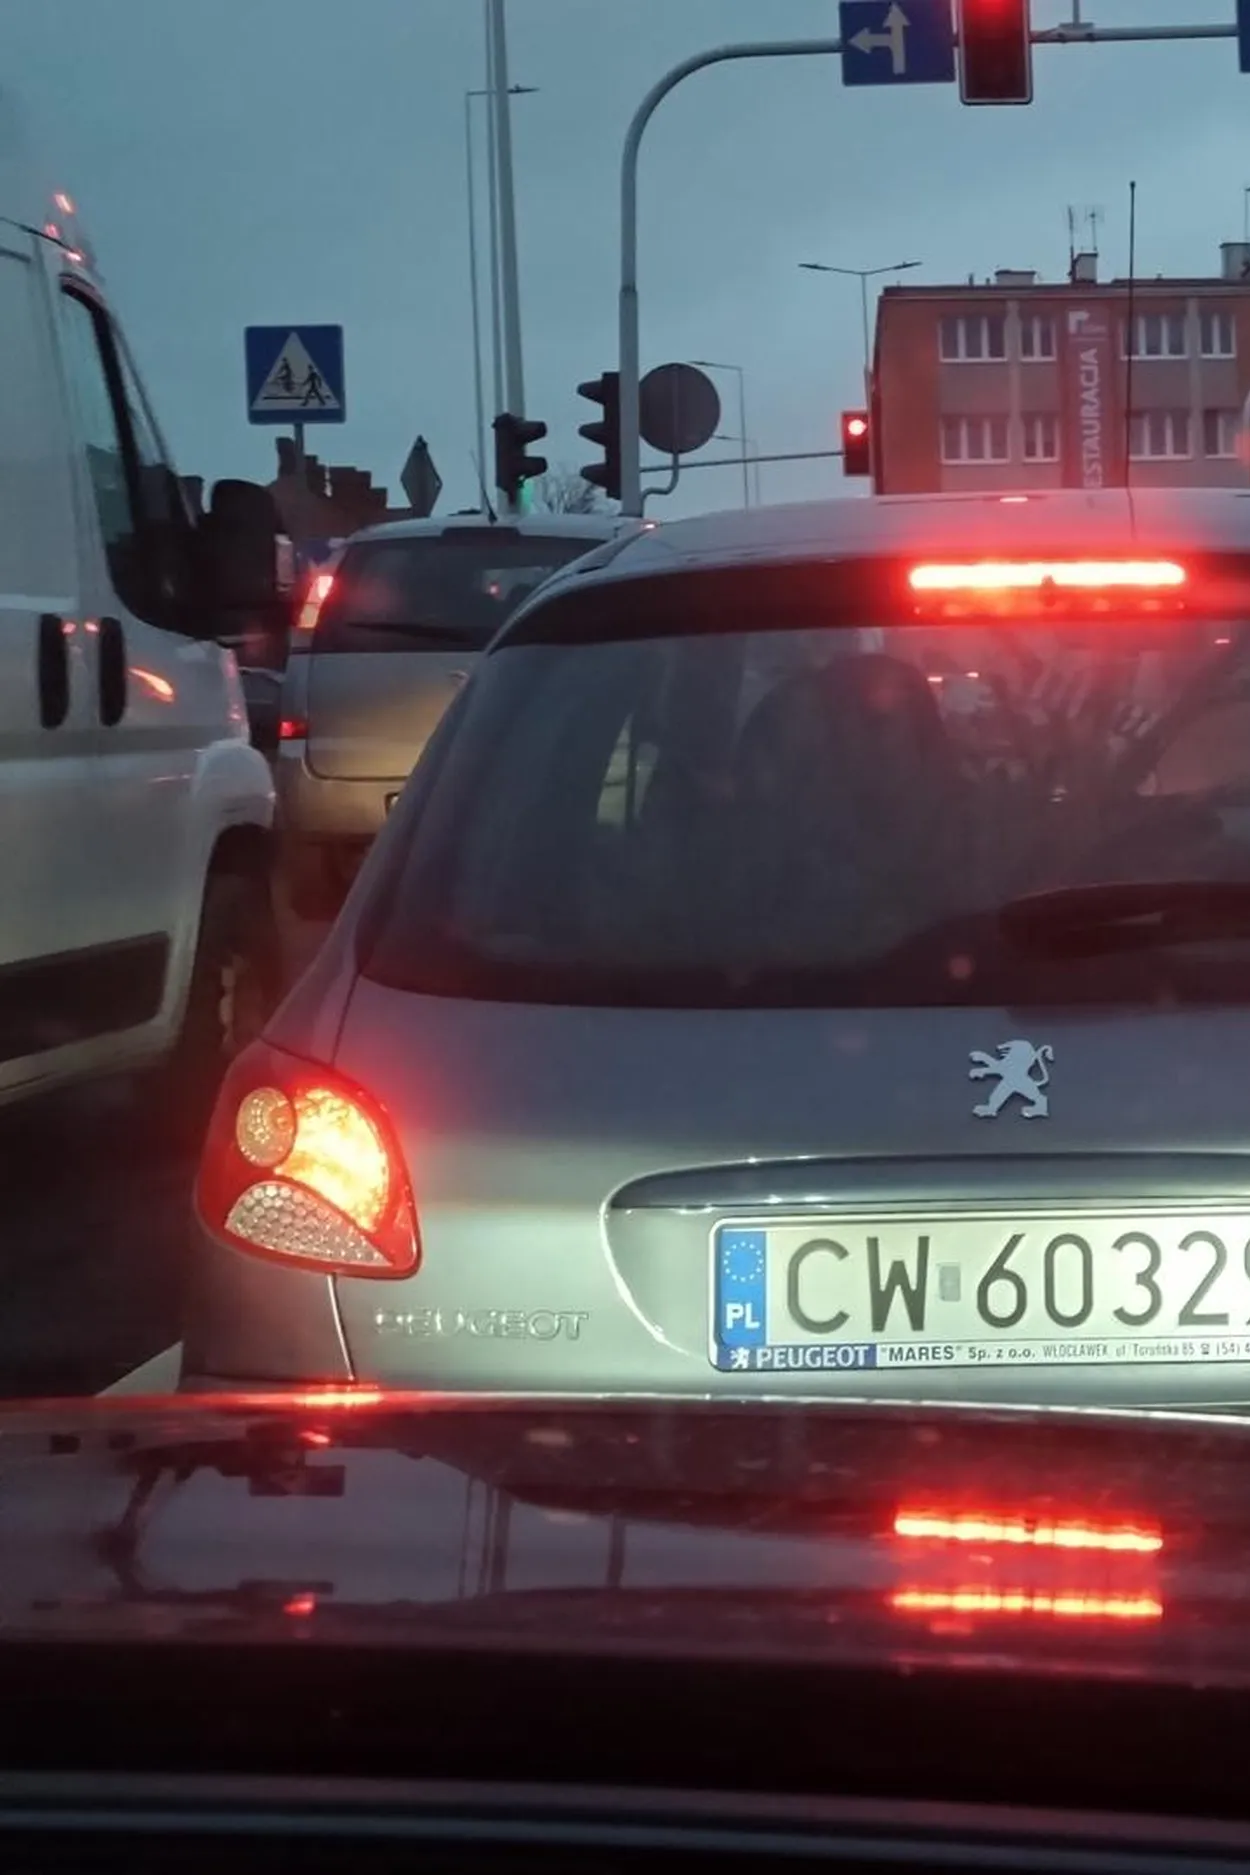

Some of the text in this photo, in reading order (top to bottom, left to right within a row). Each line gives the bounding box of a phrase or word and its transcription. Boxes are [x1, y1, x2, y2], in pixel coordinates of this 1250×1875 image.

[1080, 347, 1103, 487] ESTAURACJA
[786, 1235, 930, 1334] CW
[725, 1303, 761, 1330] PL
[755, 1346, 870, 1369] PEUGEOT
[968, 1347, 991, 1361] Sp.
[996, 1348, 1003, 1359] z
[1008, 1347, 1036, 1358] o.o.
